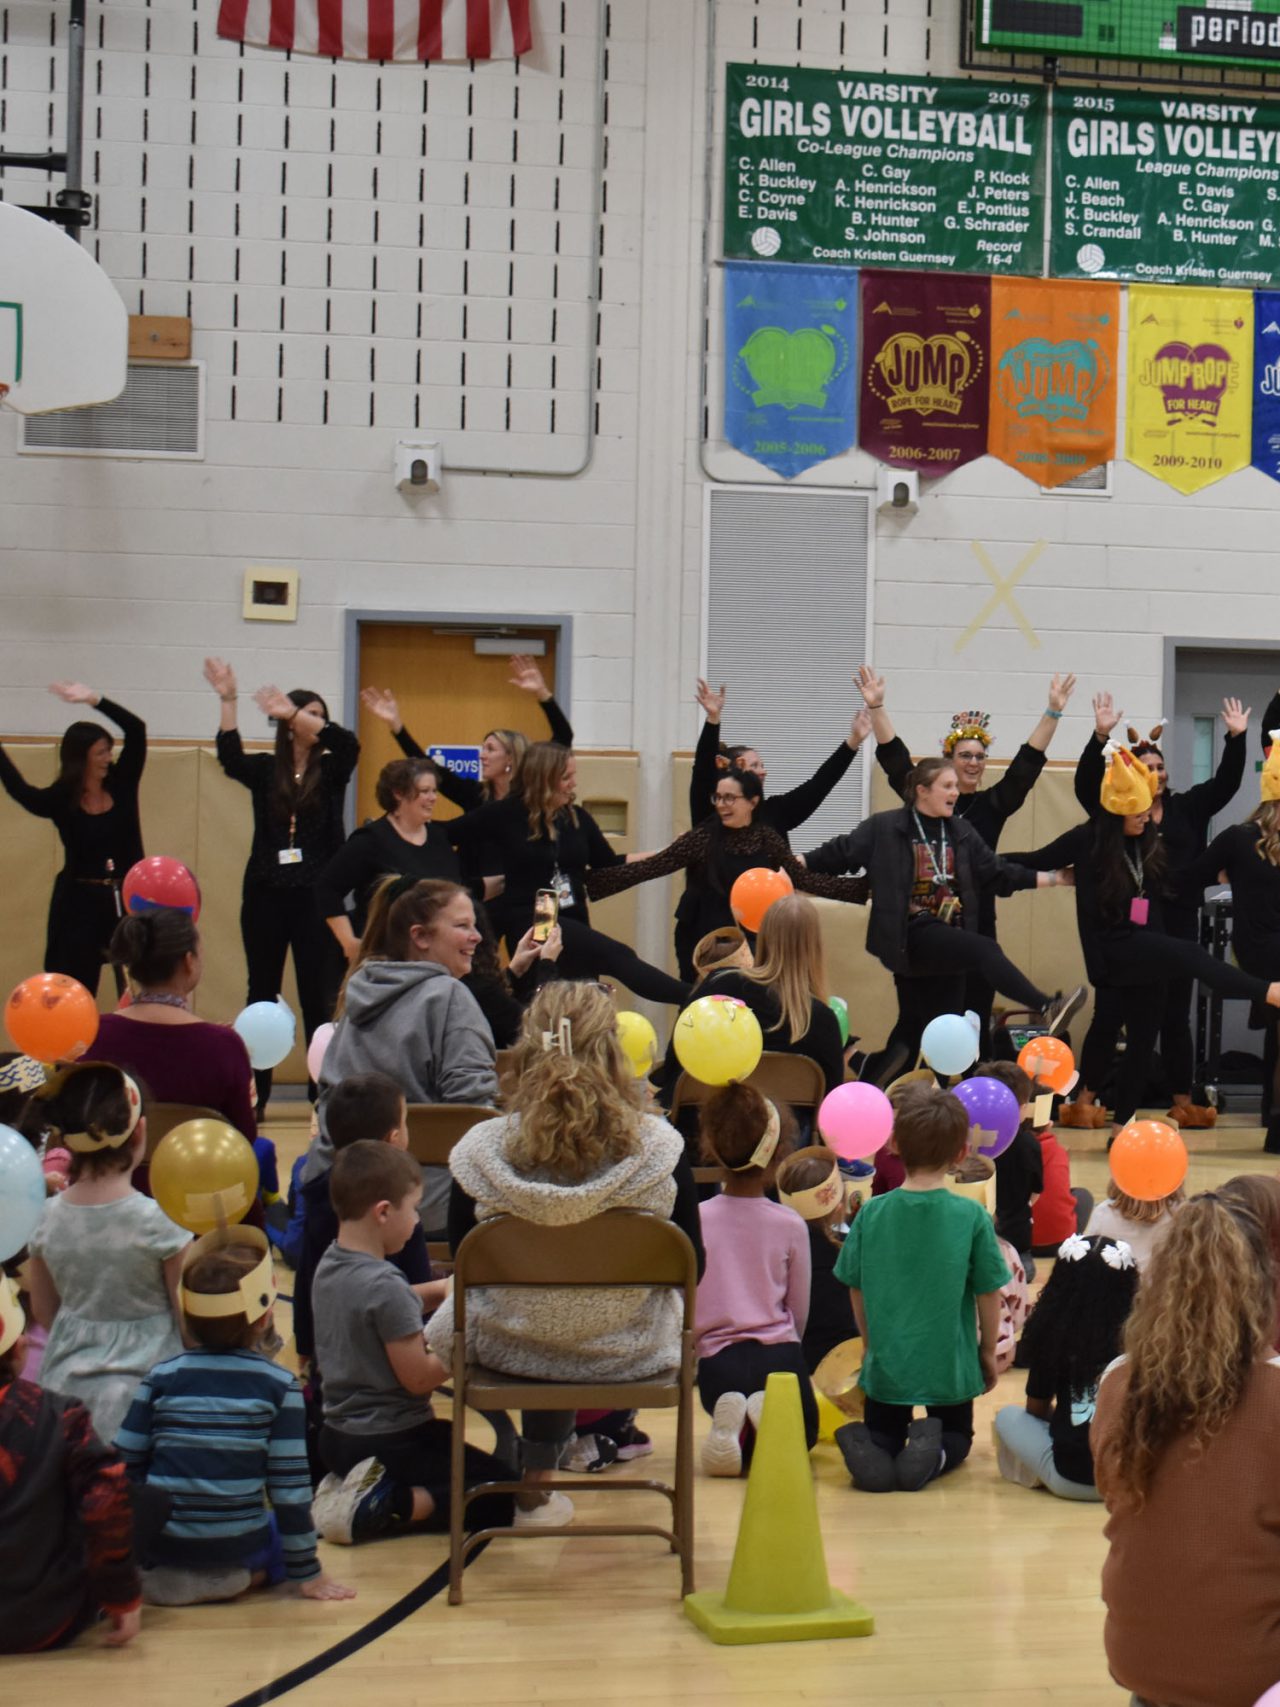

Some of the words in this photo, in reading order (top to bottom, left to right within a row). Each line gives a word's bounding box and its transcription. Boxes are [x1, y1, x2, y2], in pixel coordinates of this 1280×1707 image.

[746, 75, 789, 92] 2014
[838, 81, 938, 104] VARSITY
[989, 92, 1029, 108] 2015
[1074, 97, 1114, 112] 2015
[1161, 101, 1256, 123] VARSITY
[740, 98, 831, 138] GIRLS
[841, 105, 1031, 155] VOLLEYBALL
[1068, 118, 1155, 157] GIRLS
[797, 139, 882, 159] Co-League
[887, 144, 974, 163] Champions
[739, 157, 754, 170] C.
[759, 158, 796, 172] Allen
[1136, 159, 1191, 176] League
[1196, 162, 1279, 181] Champions
[862, 164, 877, 177] C.
[882, 165, 910, 182] Gay
[975, 170, 985, 182] P.
[990, 171, 1029, 185] Klock
[739, 173, 753, 186] K.
[759, 174, 816, 192] Buckley
[835, 179, 850, 191] A.
[855, 178, 936, 196] Henrickson
[1065, 175, 1080, 188] C.
[1084, 176, 1119, 190] Allen
[1179, 182, 1192, 195] E.
[1196, 183, 1234, 198] Davis
[739, 189, 754, 202] C.
[759, 190, 805, 207] Coyne
[967, 186, 978, 198] J.
[984, 186, 1029, 201] Peters
[1065, 191, 1077, 203] J.
[1082, 192, 1125, 206] Beach
[1267, 188, 1280, 200] S.
[835, 194, 850, 207] K.
[855, 196, 936, 212] Henrickson
[958, 201, 971, 213] E.
[976, 202, 1029, 217] Pontius
[1183, 198, 1197, 211] C.
[1202, 199, 1229, 218] Gay
[739, 205, 752, 218] E.
[757, 206, 797, 221] Davis
[852, 212, 866, 224] B.
[871, 213, 919, 227] Hunter
[1065, 207, 1079, 219] K.
[1084, 208, 1139, 225] Buckley
[1157, 212, 1171, 225] A.
[1176, 212, 1254, 230] Henrickson
[944, 216, 960, 229] G.
[965, 217, 1029, 232] Schrader
[1065, 222, 1078, 235] S.
[1083, 222, 1141, 239] Crandall
[1262, 219, 1276, 232] G.
[845, 227, 859, 240] S.
[863, 229, 925, 243] Johnson
[1173, 229, 1187, 242] B.
[1191, 231, 1238, 245] Hunter
[1259, 234, 1274, 247] M.
[977, 240, 1022, 253] Record
[813, 246, 851, 258] Coach
[854, 249, 896, 260] Kristen
[899, 251, 955, 266] Guernsey
[987, 254, 1012, 266] 16-4
[1136, 263, 1172, 278] Coach
[1175, 263, 1215, 279] Kristen
[1218, 268, 1272, 284] Guernsey
[888, 341, 966, 397] JUMP
[1139, 356, 1193, 388] JUMP
[1192, 356, 1240, 392] ROPE
[1017, 359, 1092, 408] JUMP
[914, 396, 931, 407] FOR
[932, 396, 959, 410] HEART
[1168, 398, 1186, 411] FOR
[1187, 398, 1218, 413] HEART
[888, 445, 961, 460] 2006-2007
[1153, 454, 1223, 469] 2009-2010
[447, 759, 479, 773] BOYS
